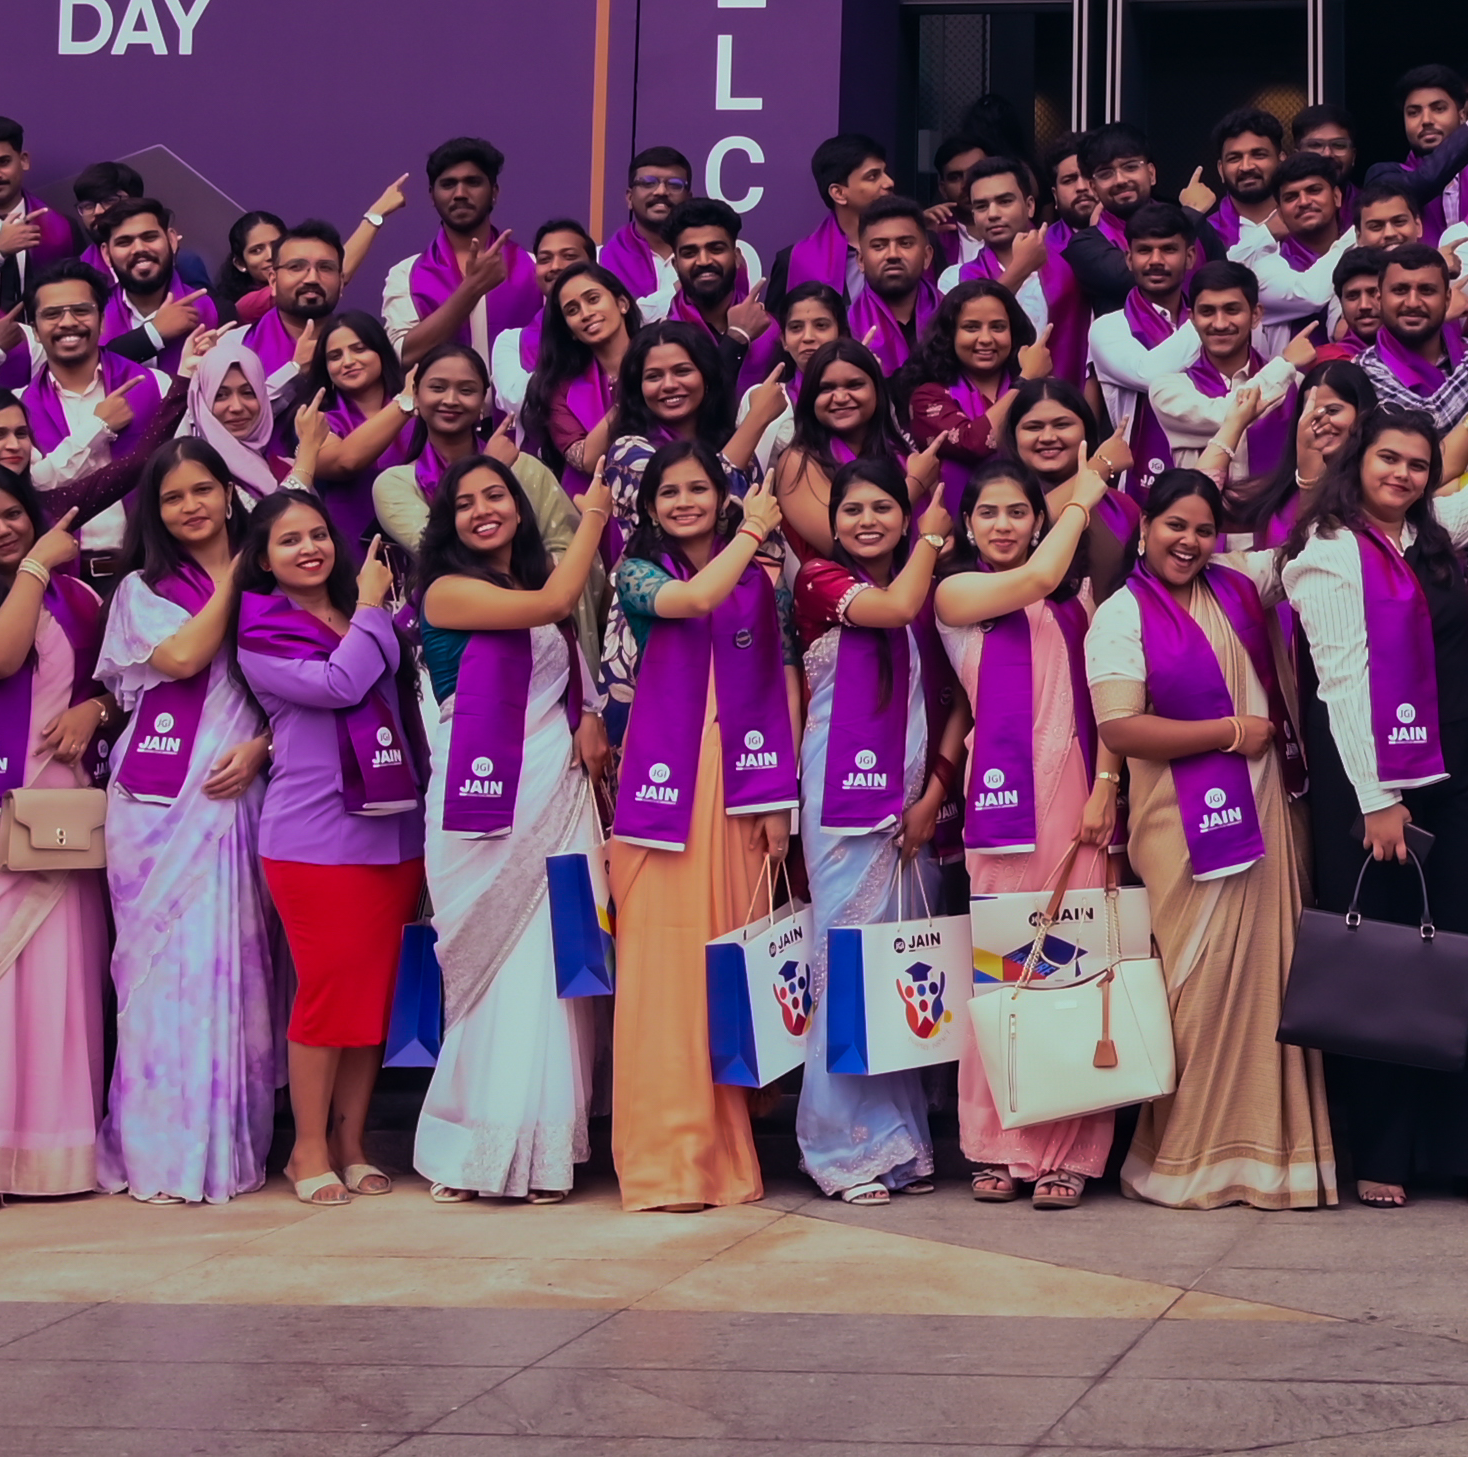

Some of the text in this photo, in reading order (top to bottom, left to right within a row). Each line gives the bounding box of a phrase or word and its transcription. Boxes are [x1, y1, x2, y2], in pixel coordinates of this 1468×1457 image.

[1140, 474, 1155, 487] JA
[1388, 726, 1428, 741] JAIN
[139, 735, 181, 752] JAIN
[372, 749, 402, 764] JAIN
[735, 752, 778, 768] JAIN
[459, 780, 504, 795] JAIN
[843, 772, 888, 788] JAIN
[636, 784, 679, 802] JAIN
[975, 789, 1018, 807] JAIN
[1199, 807, 1243, 829] JAIN
[1055, 907, 1094, 922] AIN
[778, 926, 803, 950] JAIN
[908, 932, 942, 950] JAIN
